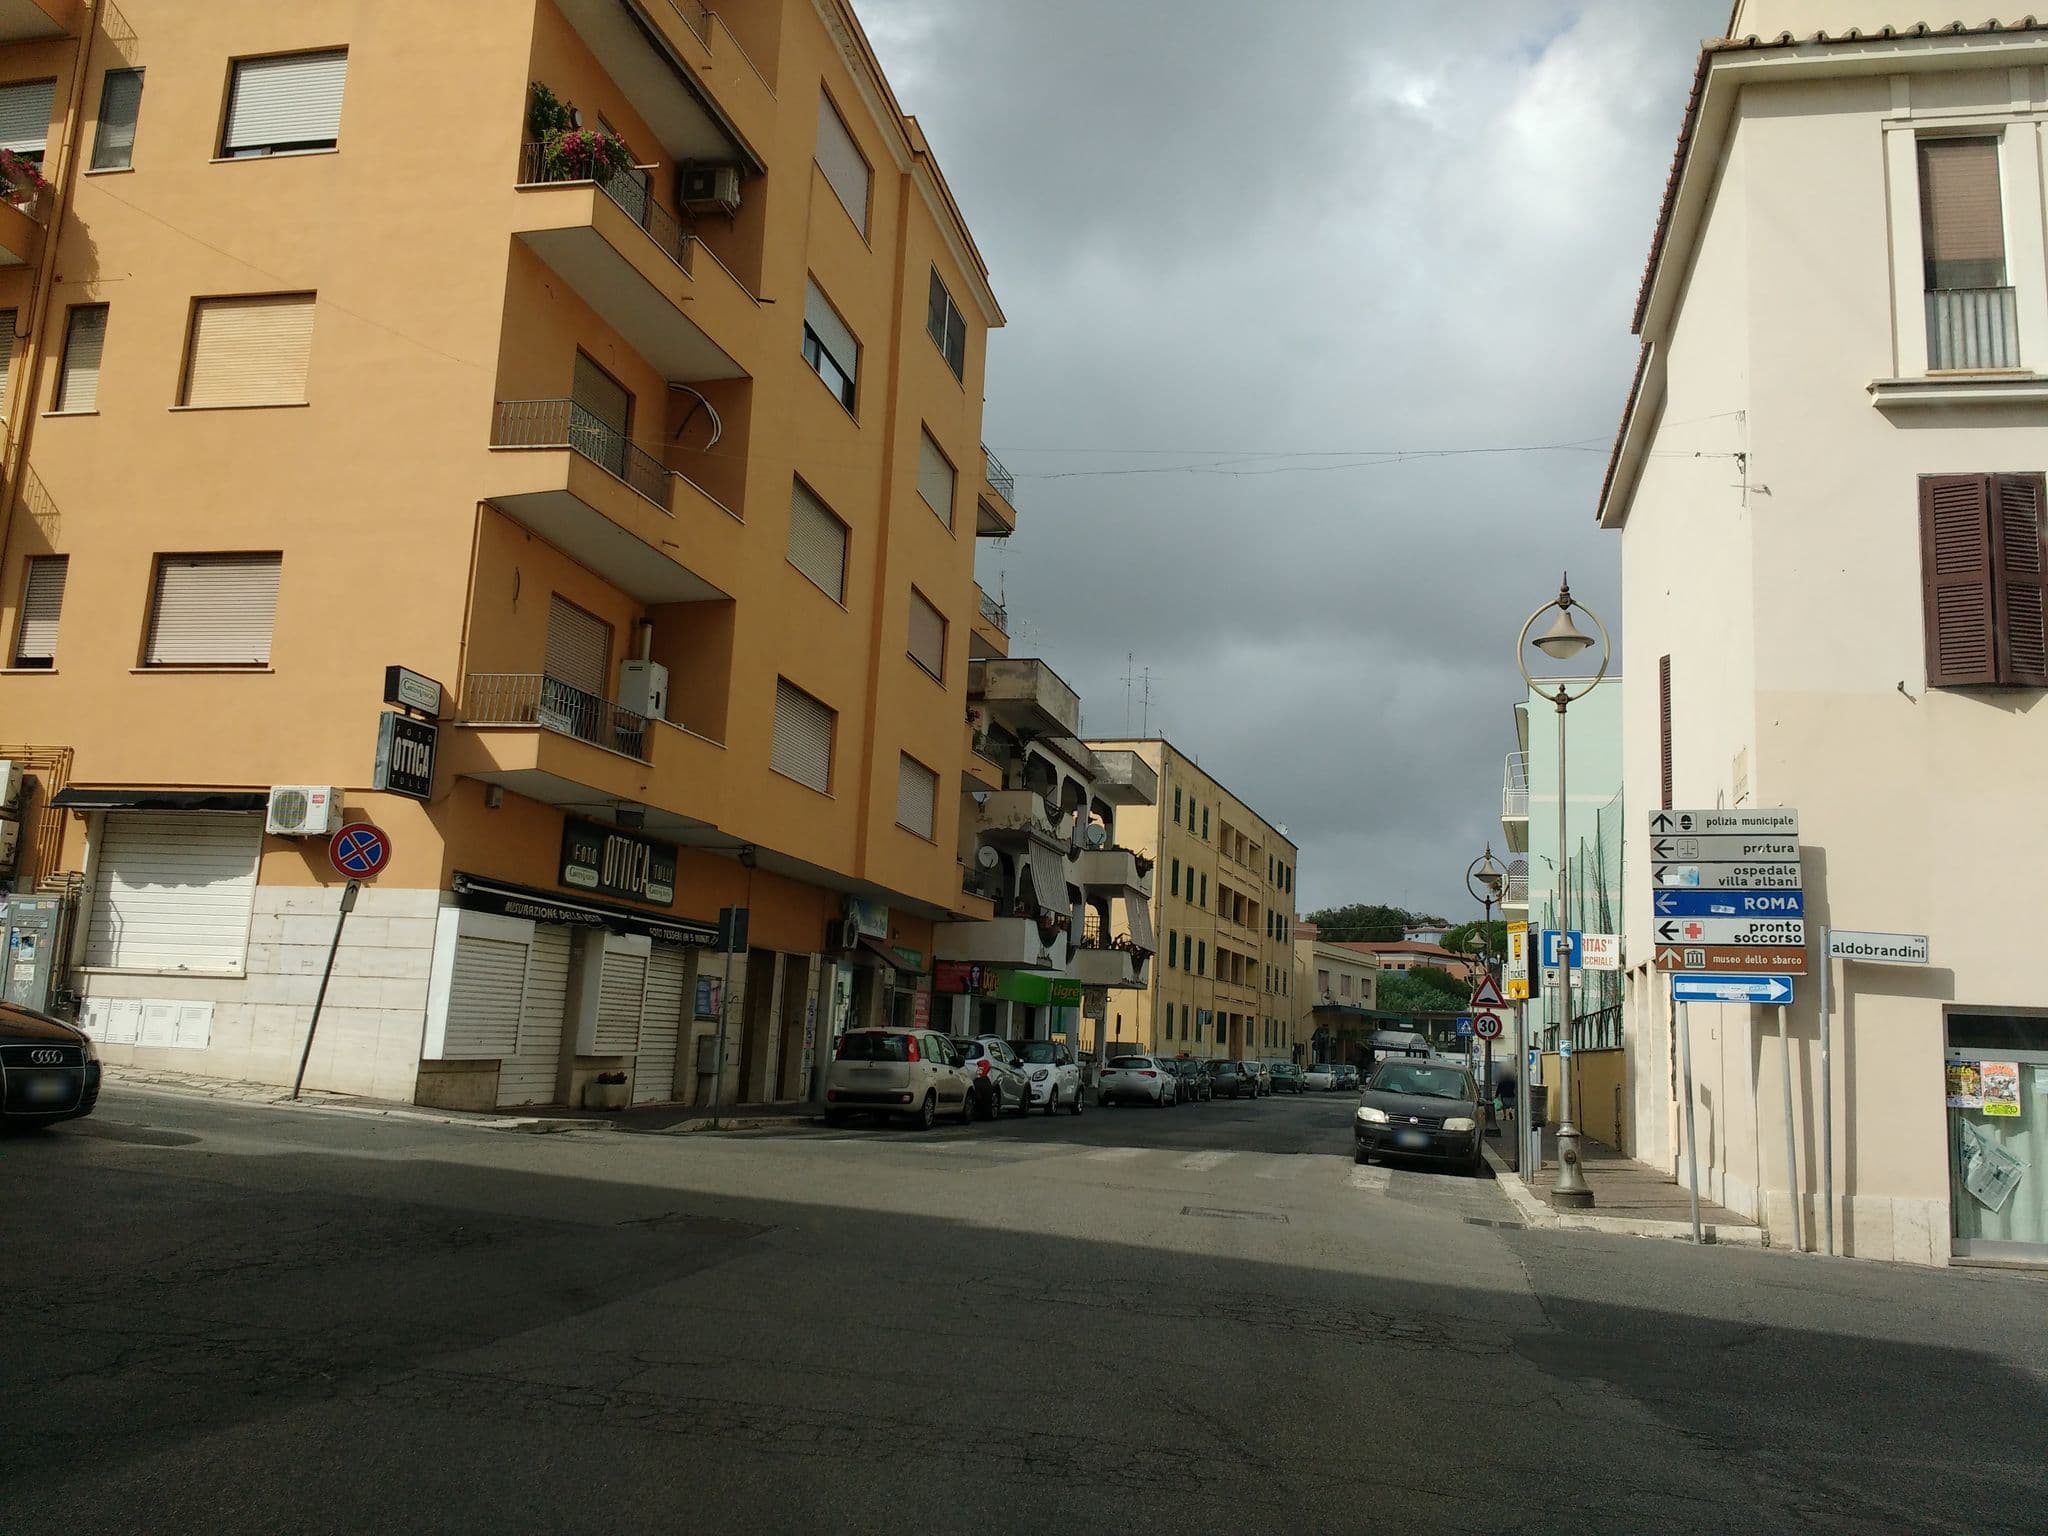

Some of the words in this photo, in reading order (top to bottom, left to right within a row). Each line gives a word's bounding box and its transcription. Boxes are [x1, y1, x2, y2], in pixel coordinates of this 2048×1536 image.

[393, 736, 429, 779] OTTICA
[1706, 816, 1737, 828] polizia
[1741, 816, 1794, 828] municipale
[574, 843, 597, 865] FOTO
[604, 834, 650, 894] OTTICA
[1734, 865, 1796, 877] ospedale
[1719, 876, 1748, 887] villa
[1754, 876, 1798, 887] albani
[505, 901, 558, 917] MISURAZIONE
[1744, 897, 1799, 911] ROMA
[1750, 921, 1801, 935] pronto
[1734, 933, 1802, 944] soccorso
[1832, 942, 1925, 960] aldobrandini
[1713, 955, 1741, 965] museo
[1745, 954, 1768, 965] dello
[1772, 955, 1802, 965] sbarco
[1479, 1020, 1496, 1034] 30
